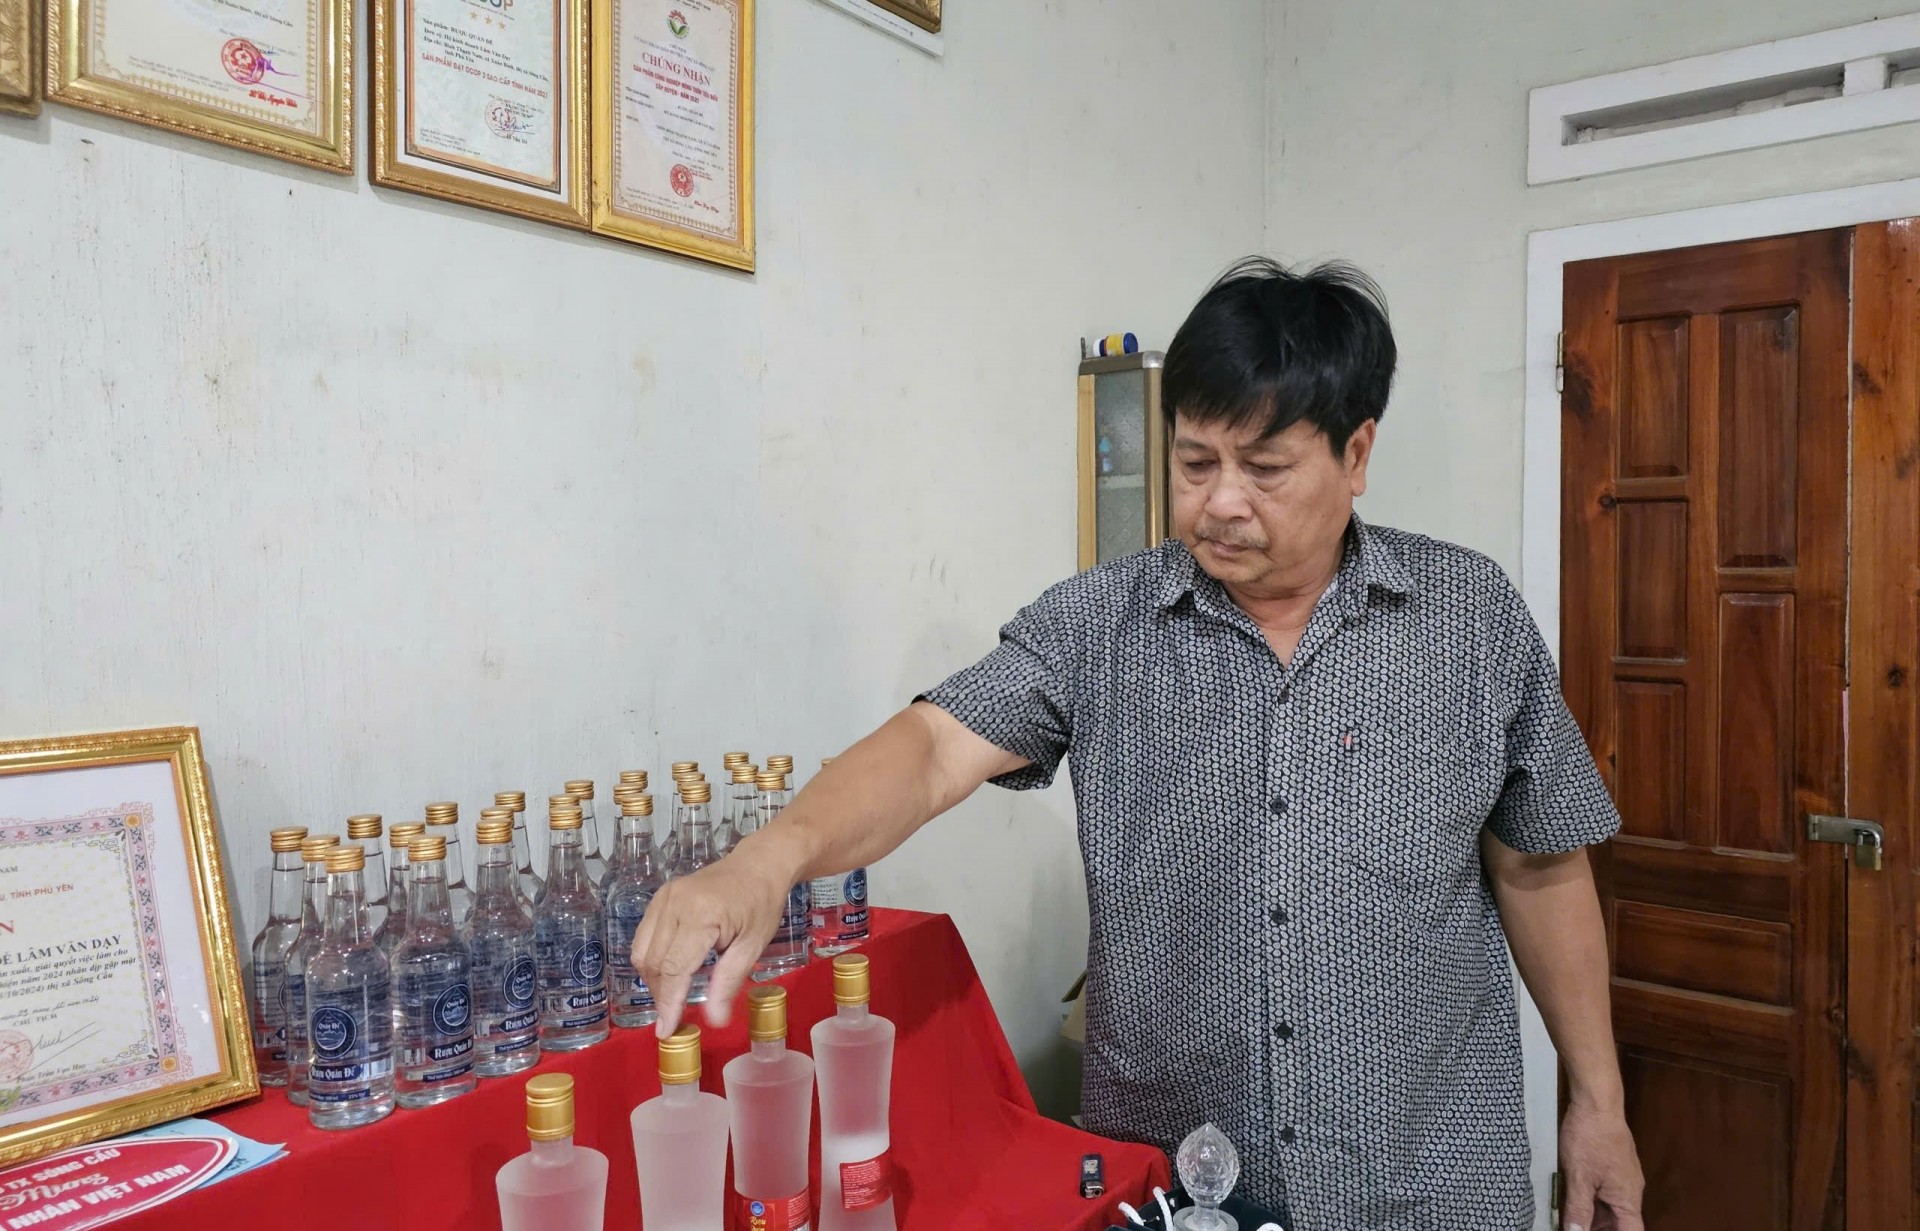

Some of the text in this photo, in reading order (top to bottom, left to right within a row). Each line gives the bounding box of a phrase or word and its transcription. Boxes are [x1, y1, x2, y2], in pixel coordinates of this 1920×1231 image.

[642, 51, 681, 75] CHỨNG
[683, 66, 711, 86] NHẬN
[17, 946, 51, 963] LÂM
[56, 940, 87, 954] VĂN
[92, 934, 121, 950] DẠY
[434, 1047, 453, 1059] Rượu
[325, 1068, 343, 1080] Quán
[344, 1065, 356, 1078] Đế
[5, 1148, 122, 1190] TX SÔNG CẦU
[7, 1164, 192, 1230] NHÂN VIỆT NAM
